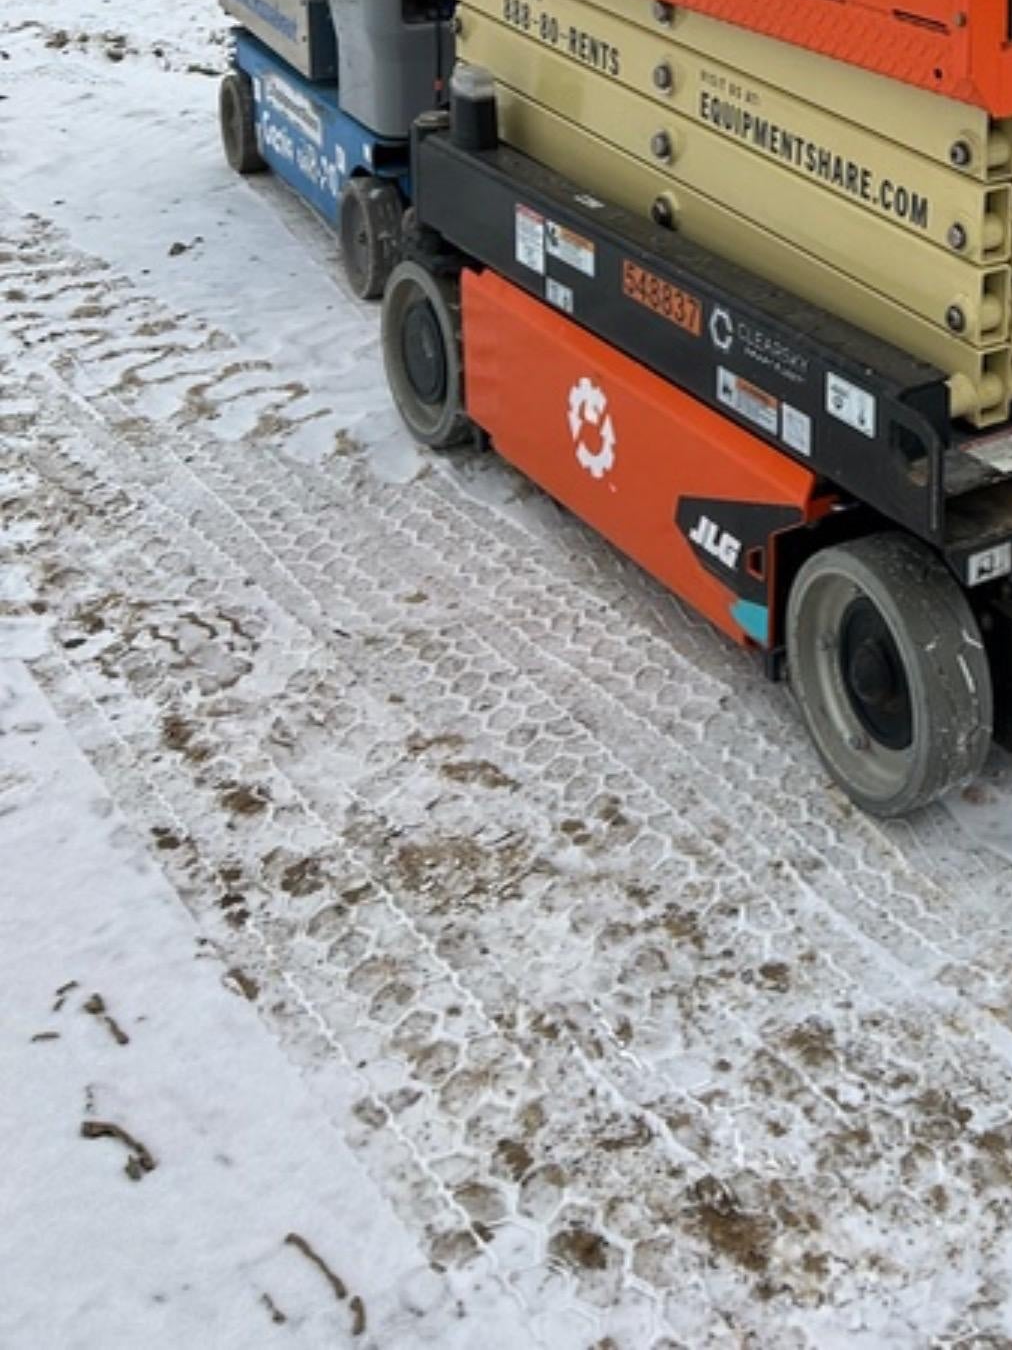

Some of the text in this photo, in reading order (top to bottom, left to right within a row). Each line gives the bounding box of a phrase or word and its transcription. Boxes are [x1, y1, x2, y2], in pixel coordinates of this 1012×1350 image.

[700, 91, 928, 230] EQUIPMENTSHARE.COM
[624, 262, 699, 330] 548837
[688, 515, 742, 569] JLG
